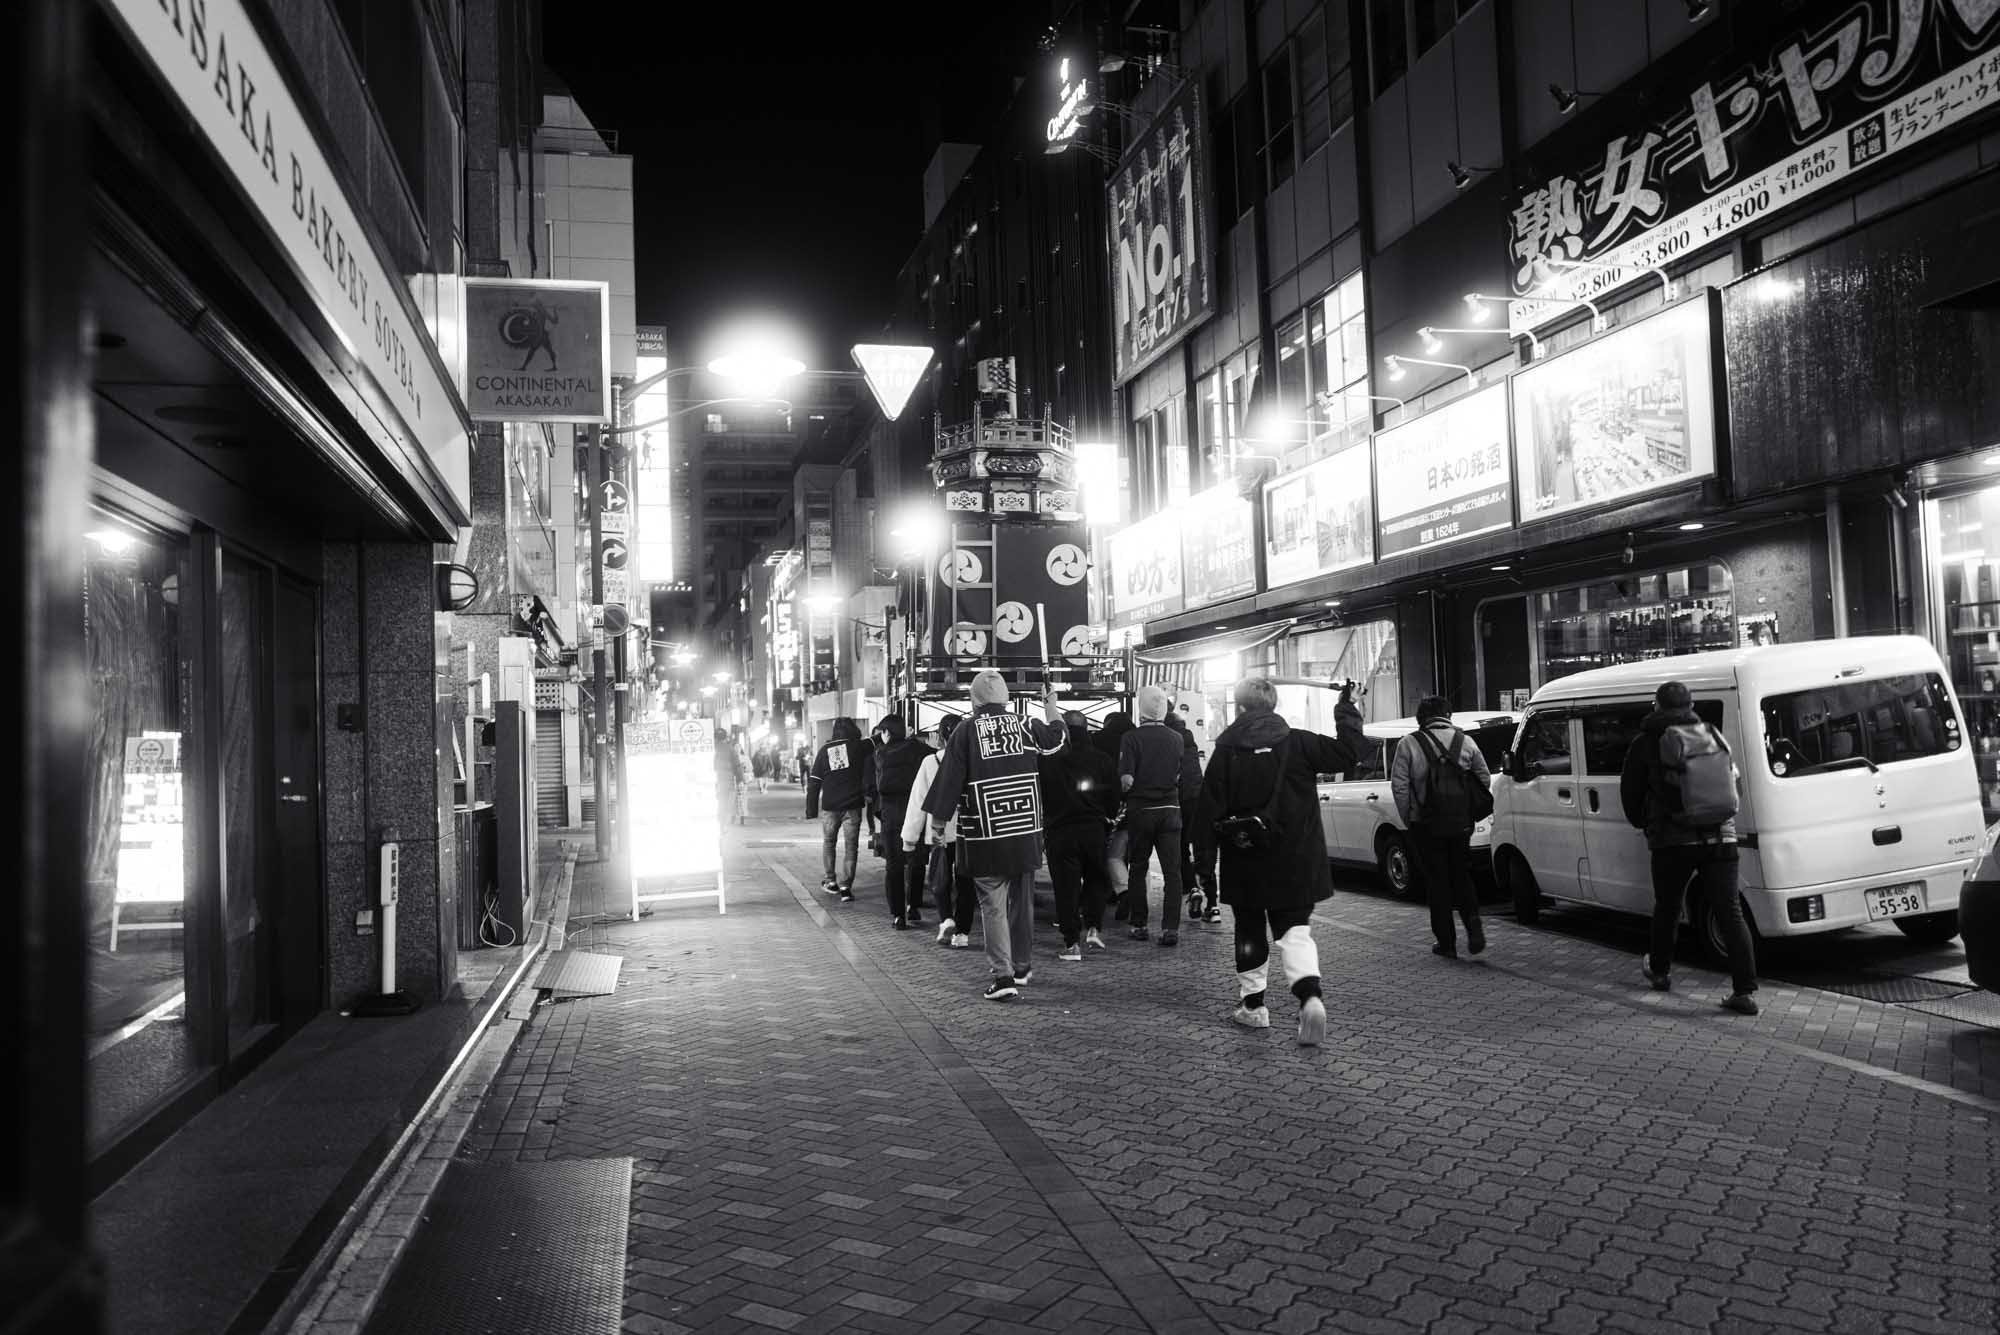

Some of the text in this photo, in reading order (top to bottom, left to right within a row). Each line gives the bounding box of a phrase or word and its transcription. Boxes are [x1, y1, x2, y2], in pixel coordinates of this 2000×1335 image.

[1120, 157, 1196, 326] No.1
[290, 152, 368, 325] BAKERY
[375, 300, 421, 420] SOYBA
[475, 375, 596, 394] CONTINENTAL
[495, 394, 562, 408] AKASAKA
[1427, 441, 1502, 491] 日本の銘酒
[1880, 895, 1920, 916] 55-98
